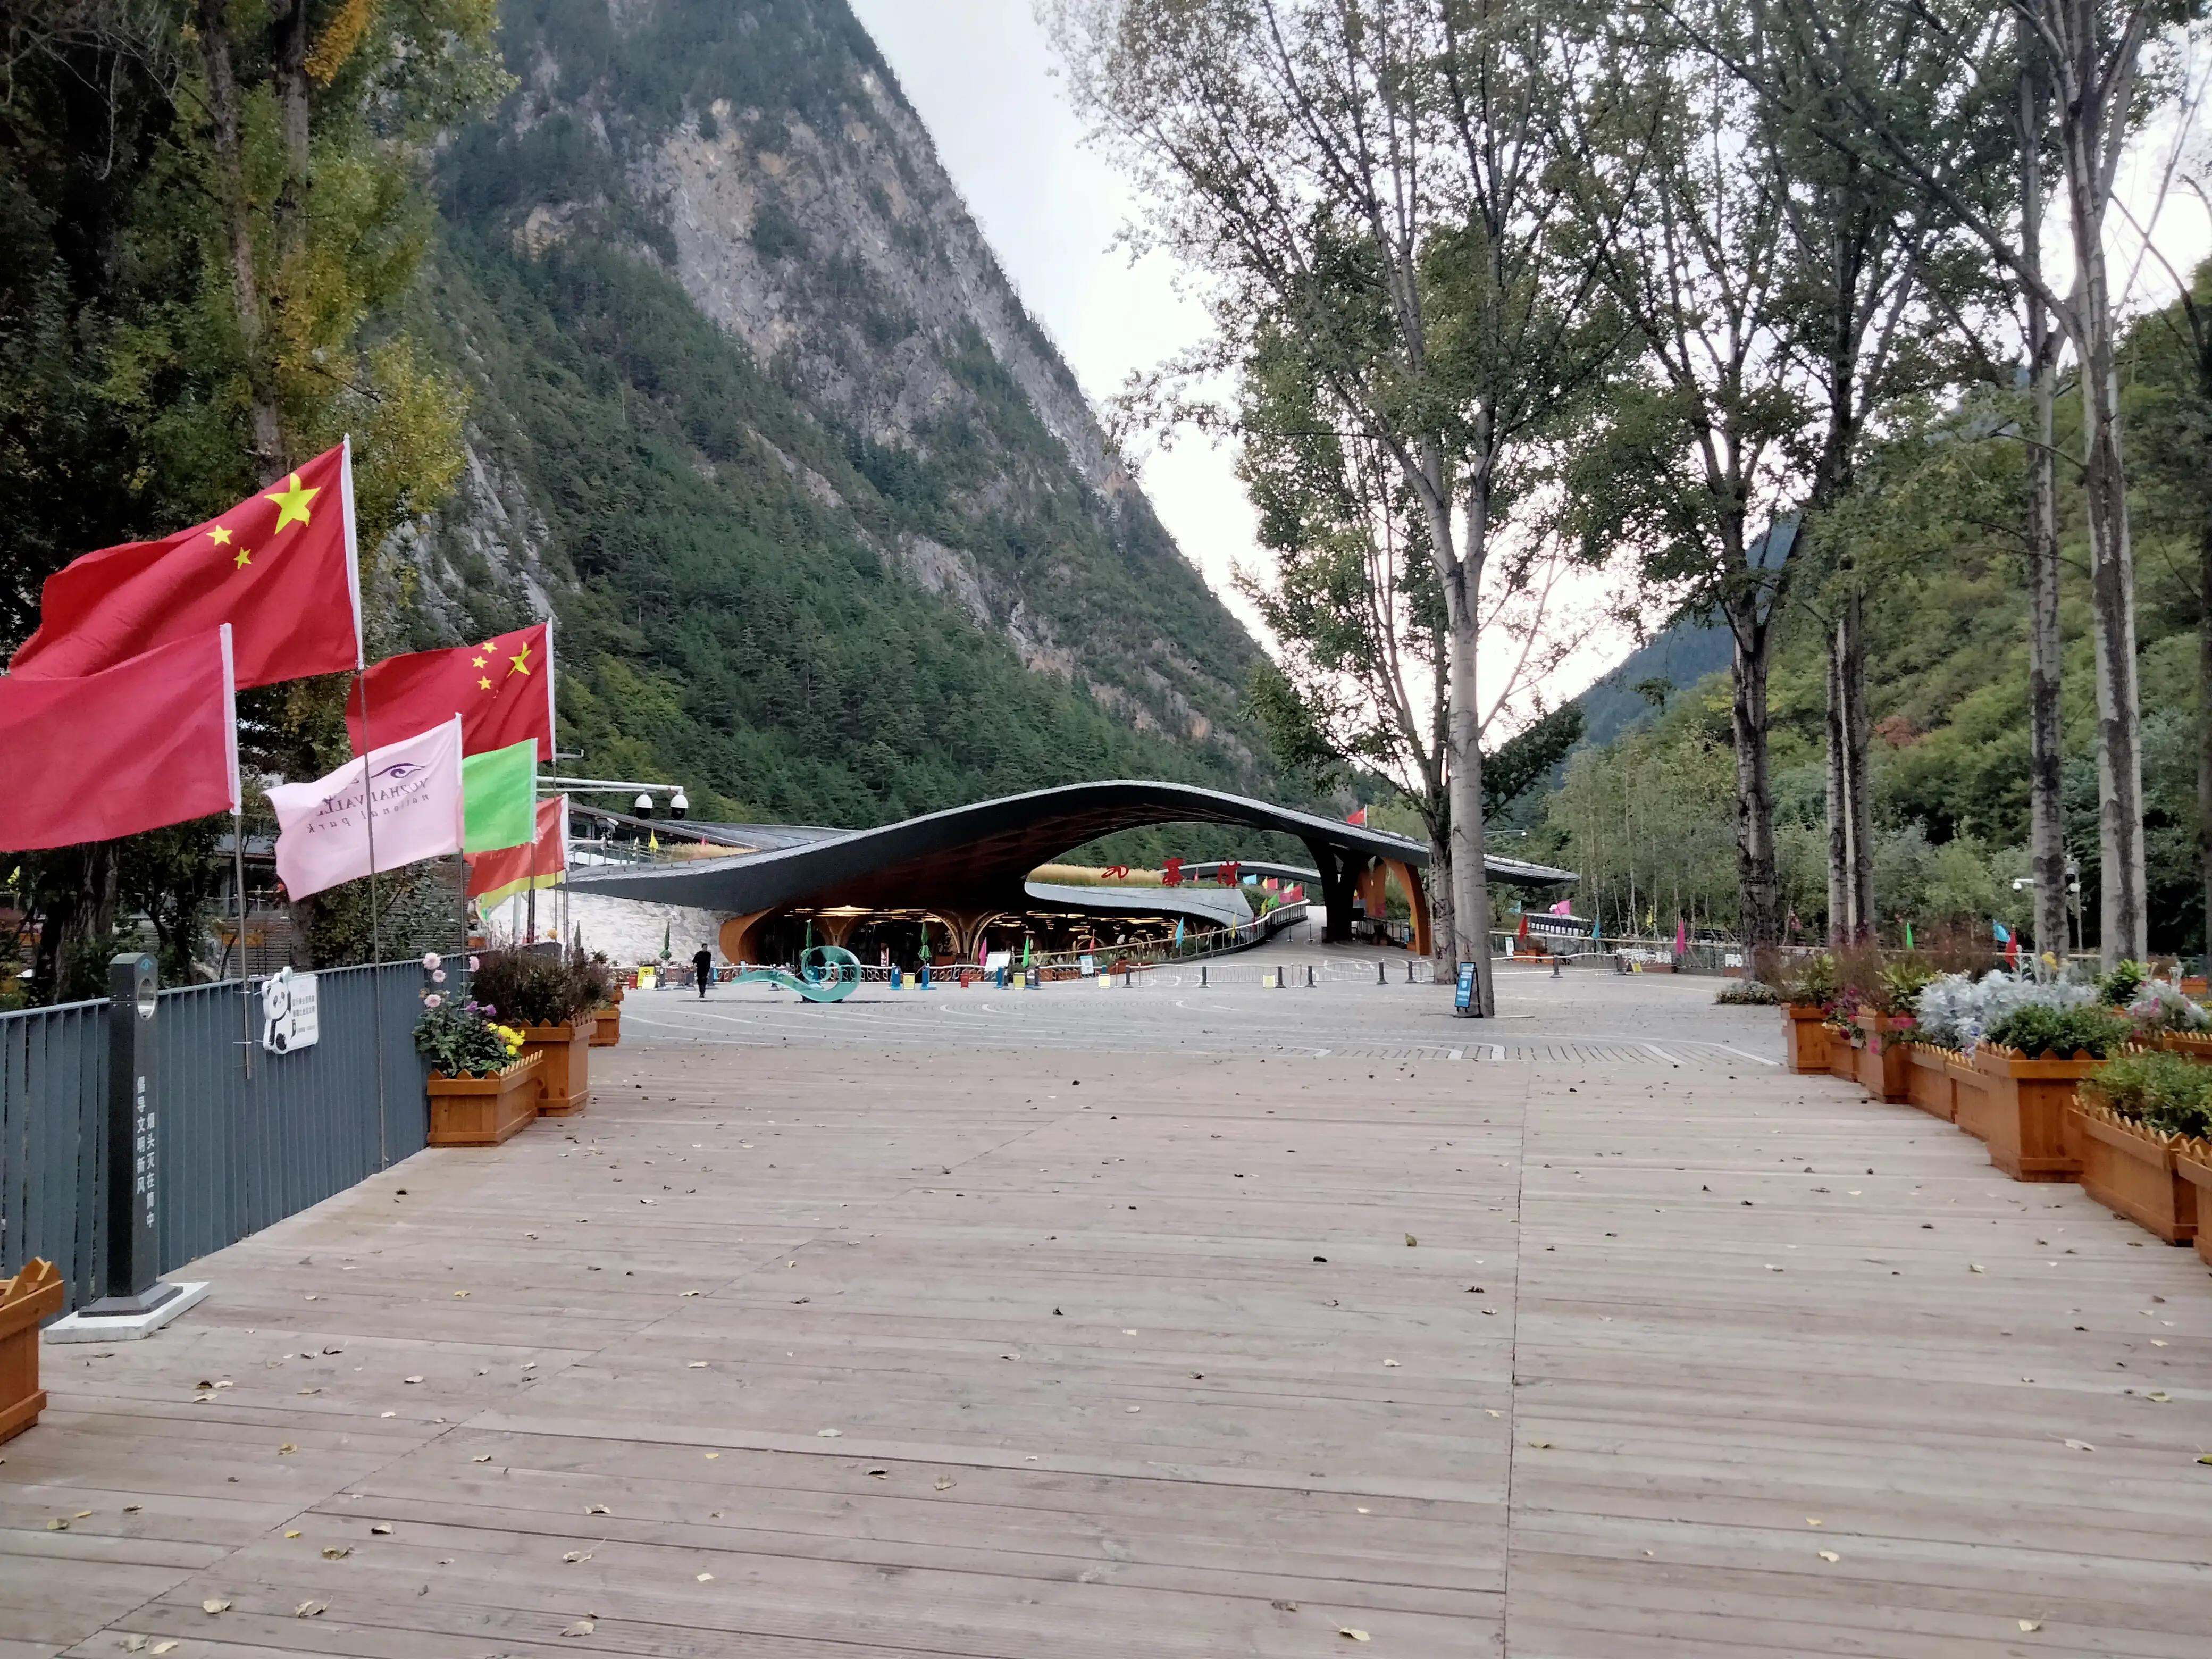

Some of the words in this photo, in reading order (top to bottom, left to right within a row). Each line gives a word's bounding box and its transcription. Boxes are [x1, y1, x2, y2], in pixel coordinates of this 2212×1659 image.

[136, 1075, 146, 1195] 倡导文明新风
